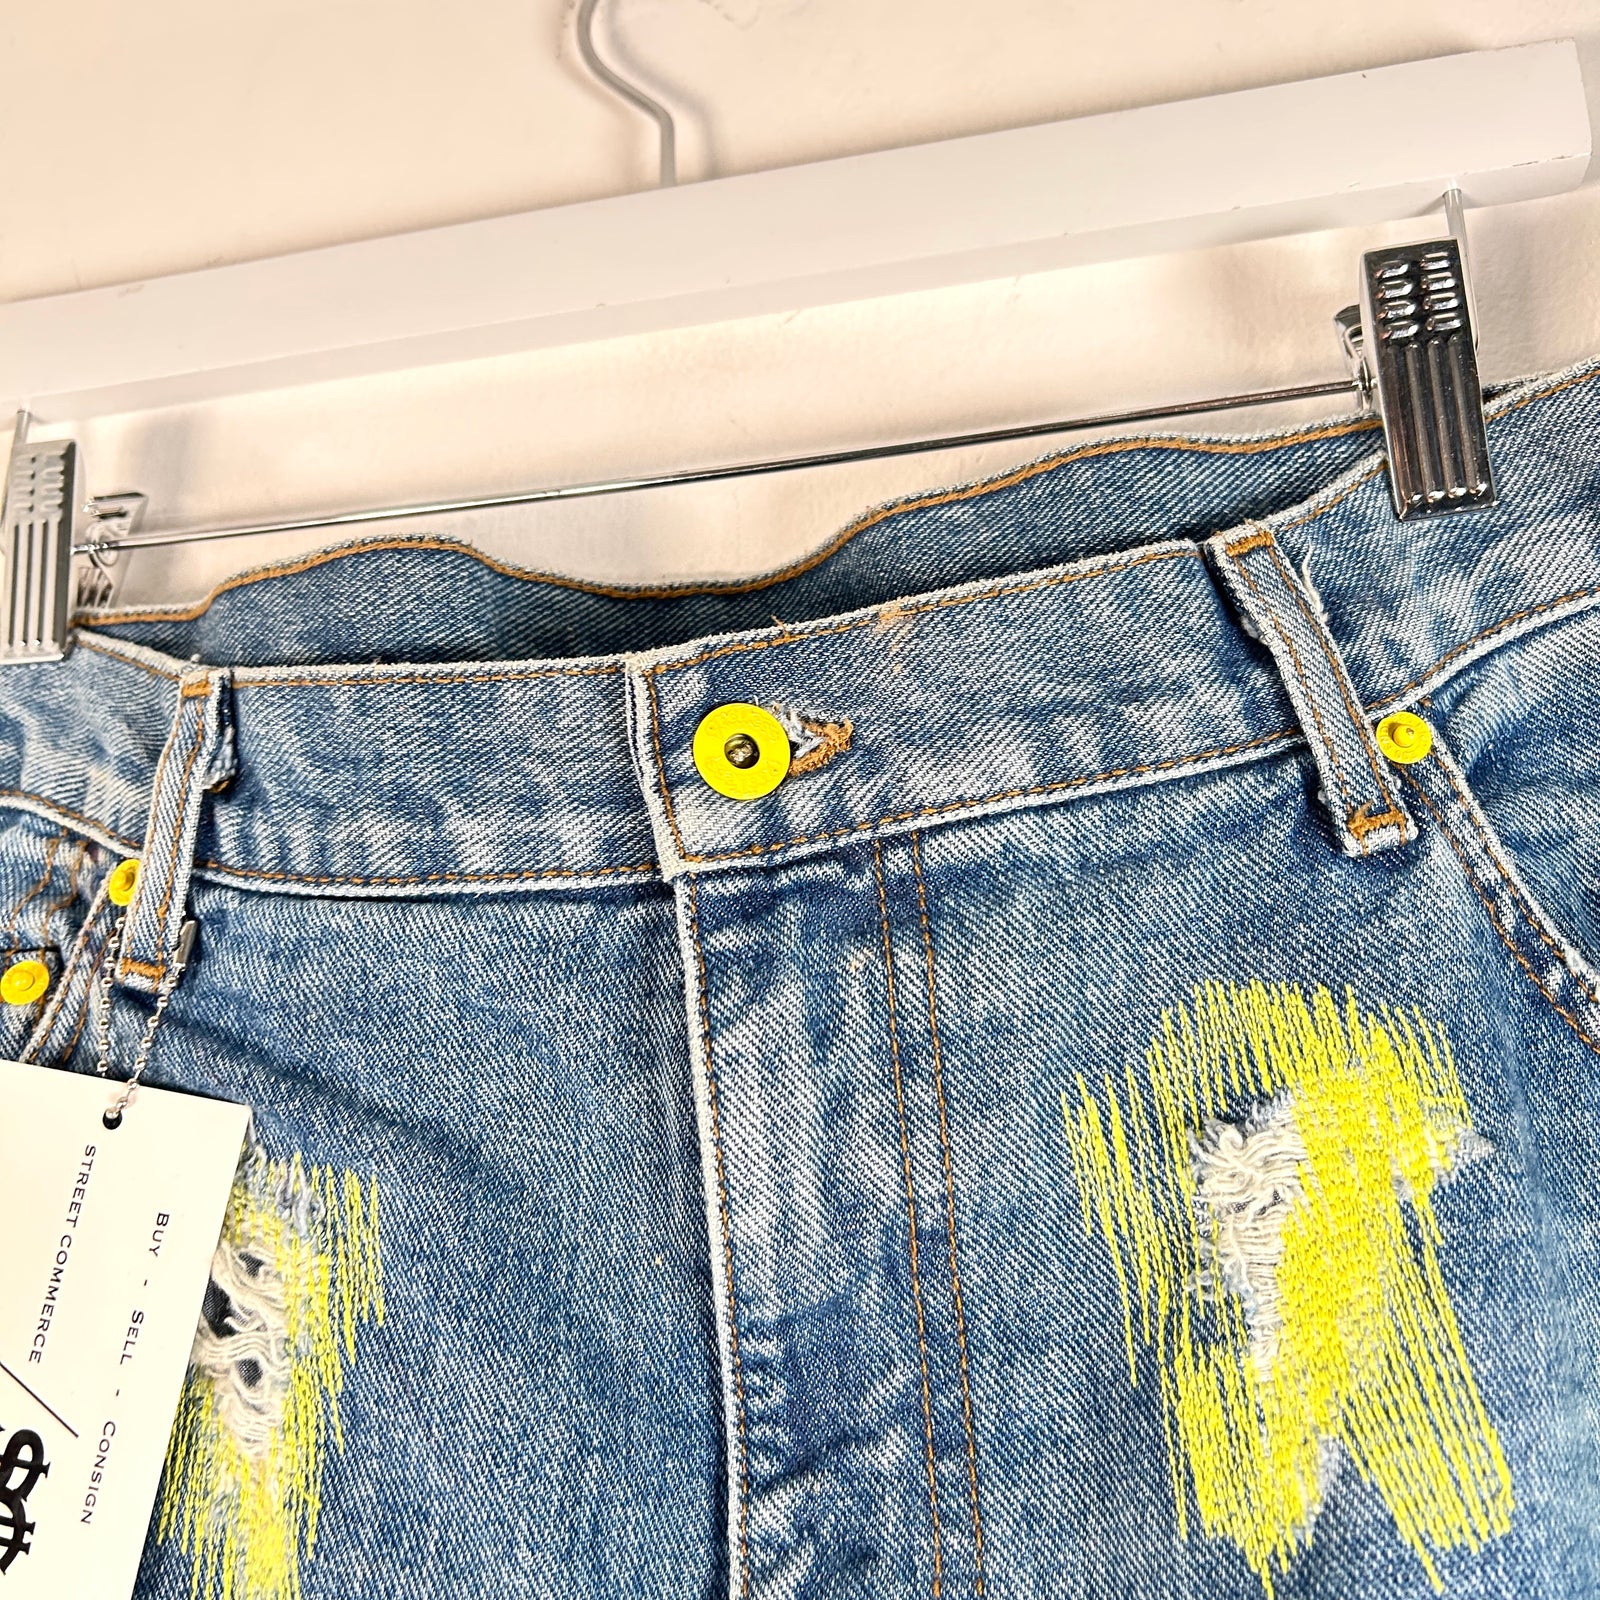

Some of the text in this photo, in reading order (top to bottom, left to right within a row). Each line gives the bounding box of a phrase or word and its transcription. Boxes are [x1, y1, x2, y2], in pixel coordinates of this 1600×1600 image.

[28, 1144, 96, 1364] STREET COMMERCE
[147, 1212, 170, 1257] BUY
[119, 1310, 145, 1365] SELL
[80, 1421, 116, 1524] CONSIGN
